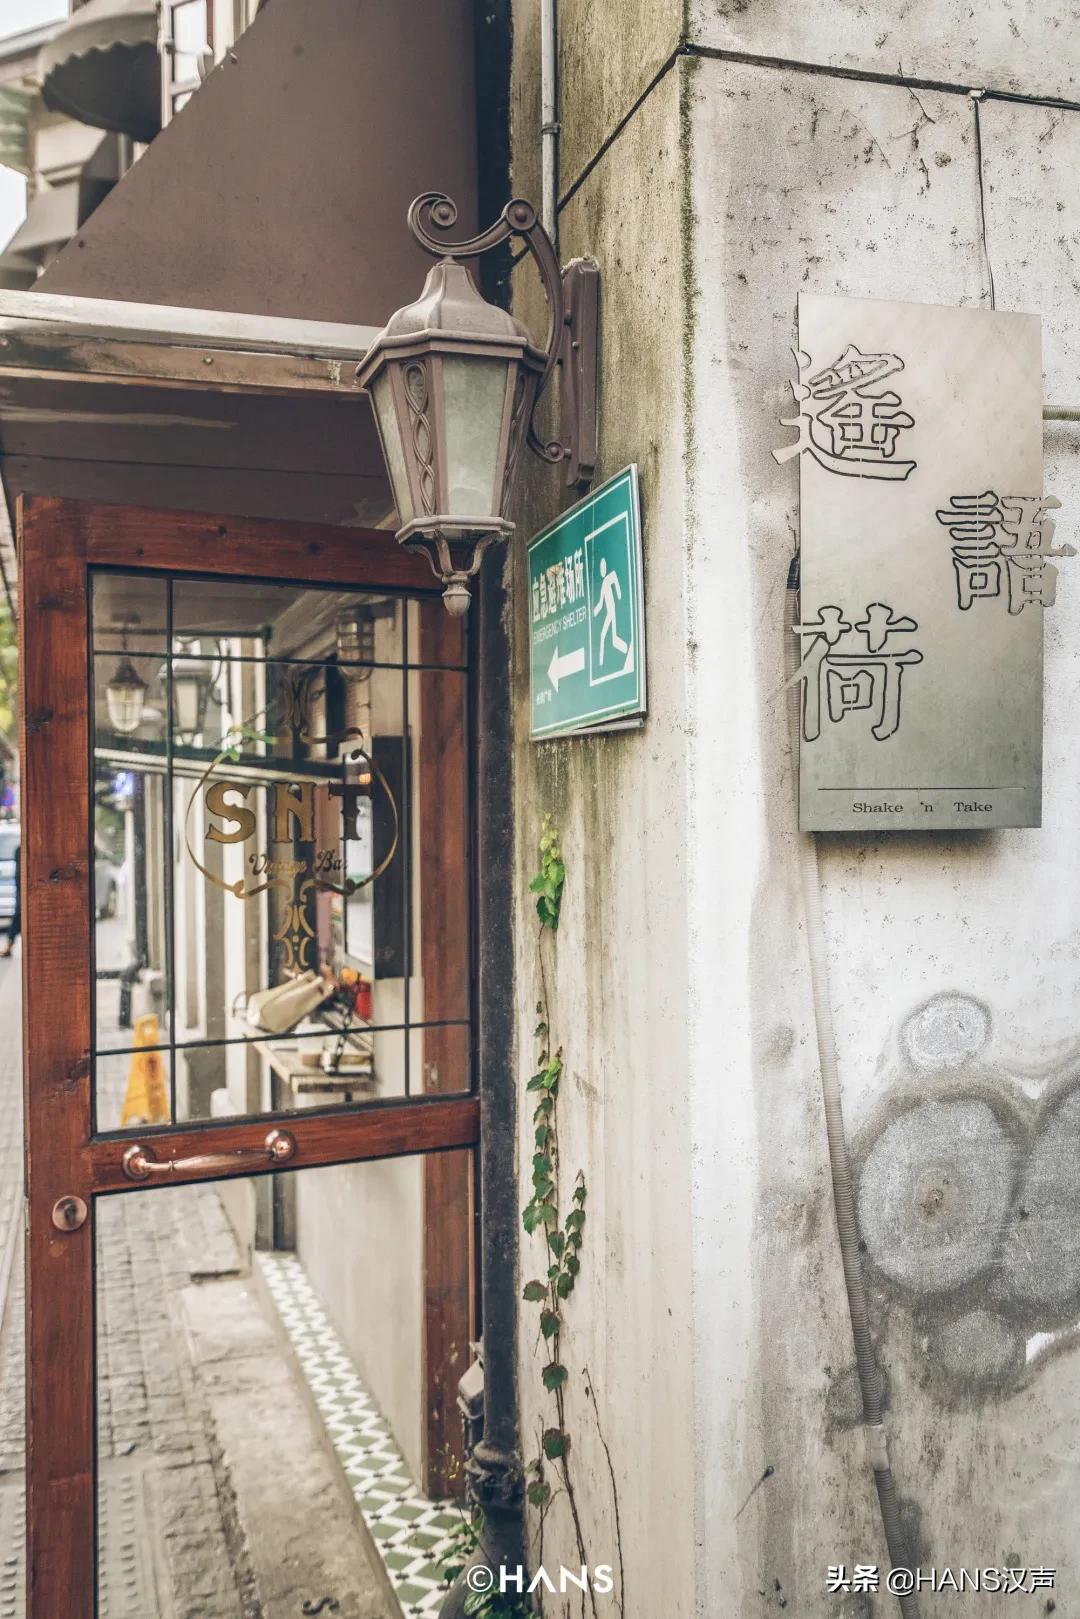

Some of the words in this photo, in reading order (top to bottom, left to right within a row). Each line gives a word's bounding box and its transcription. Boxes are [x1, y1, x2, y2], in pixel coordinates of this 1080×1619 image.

[562, 606, 586, 630] SHELTER
[781, 603, 923, 742] 荷
[205, 781, 373, 844] SNT
[852, 802, 903, 813] Shake
[954, 802, 992, 812] Take
